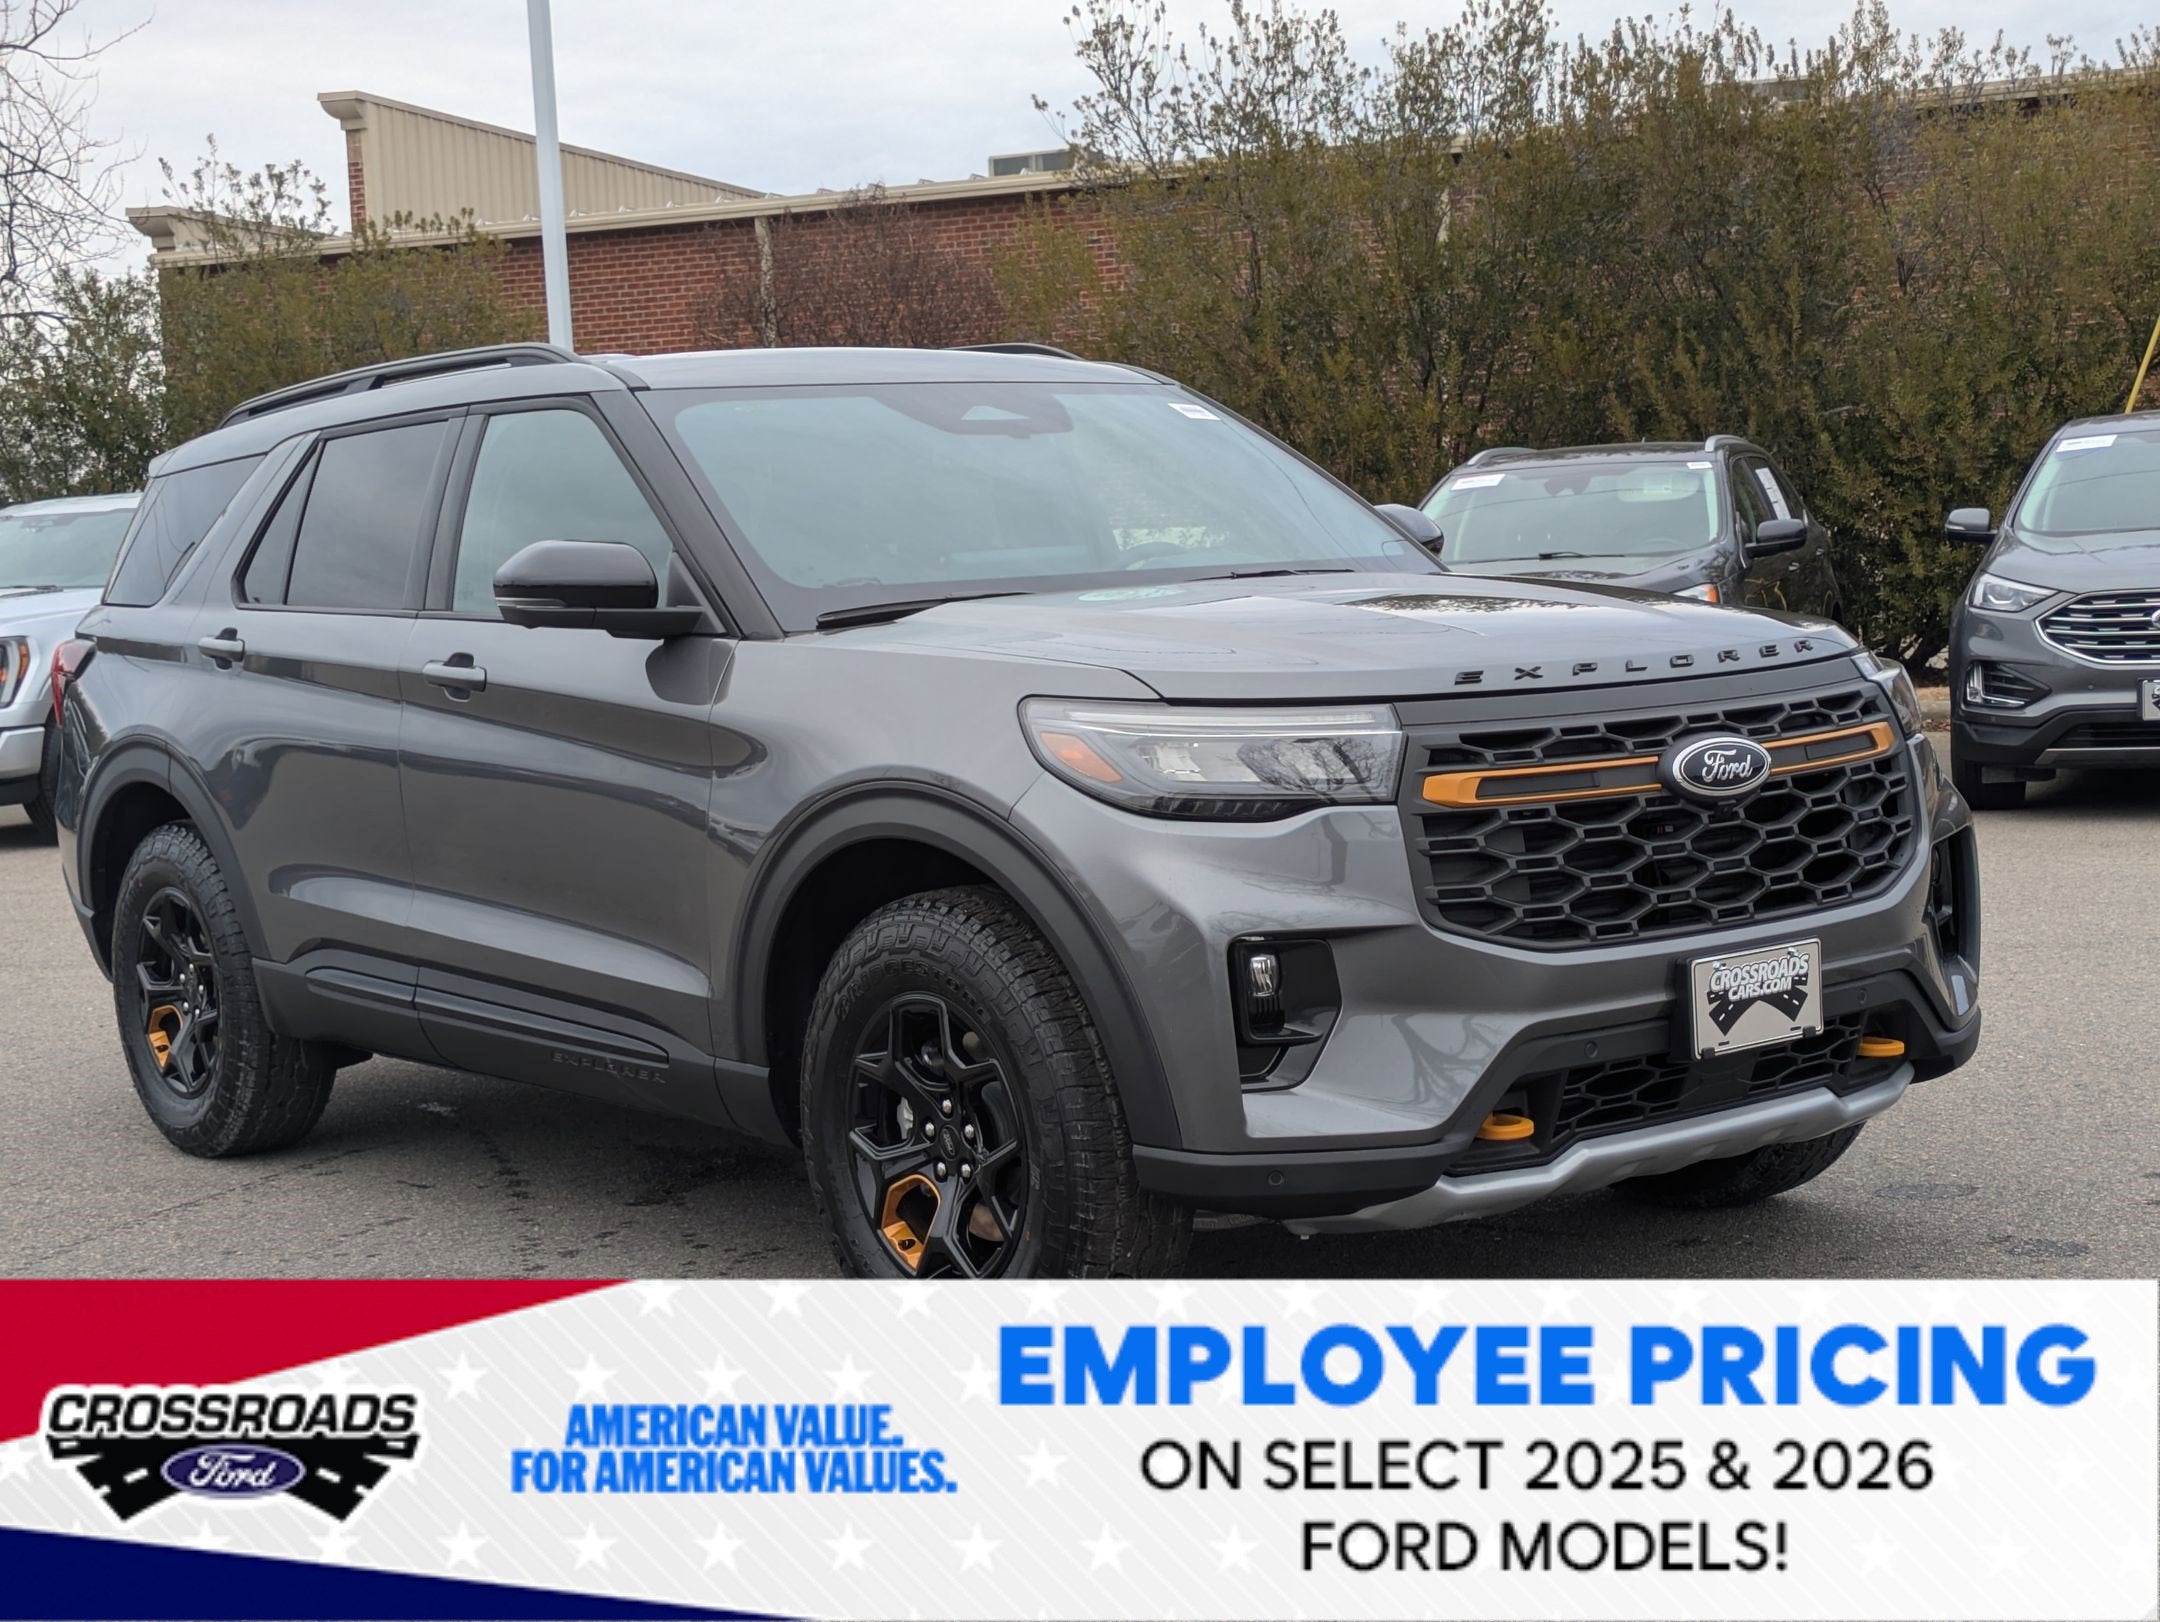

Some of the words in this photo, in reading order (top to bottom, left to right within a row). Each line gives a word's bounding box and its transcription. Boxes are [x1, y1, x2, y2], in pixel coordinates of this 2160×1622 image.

[1454, 637, 1814, 685] EXPLORER
[1701, 746, 1754, 785] Ford
[1709, 953, 1809, 991] CROSSROADS
[1728, 976, 1793, 1002] CARS.COM
